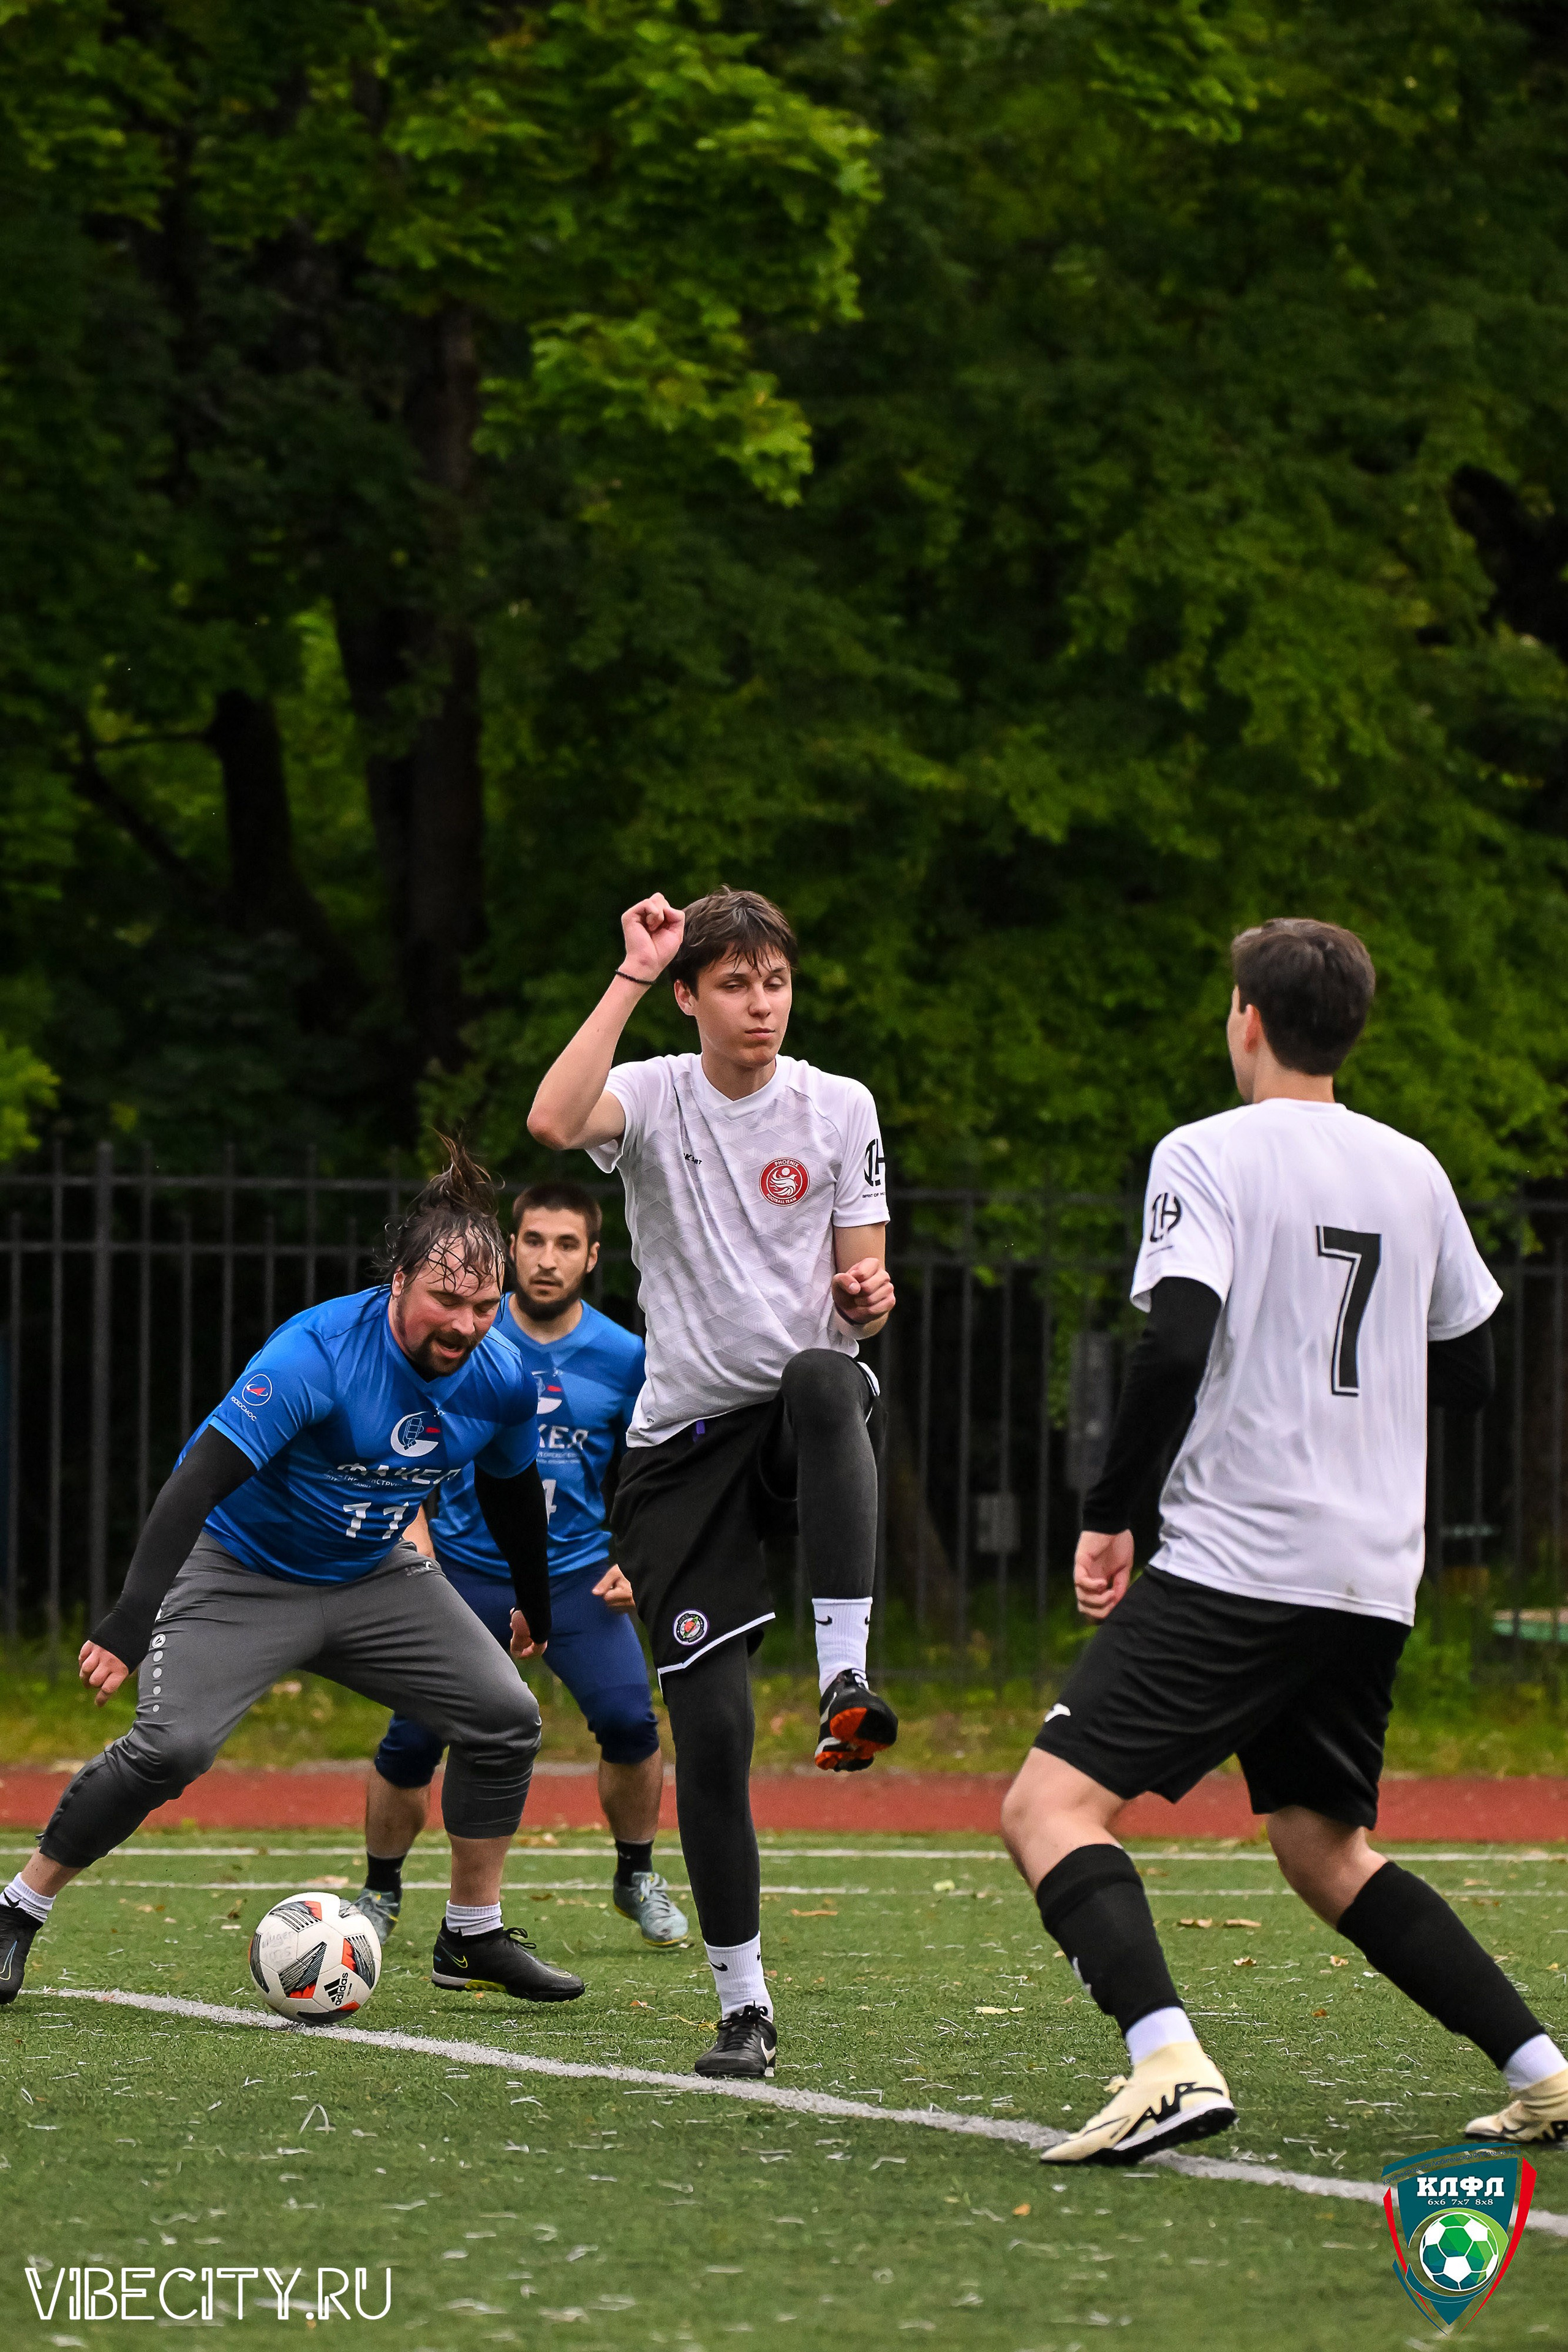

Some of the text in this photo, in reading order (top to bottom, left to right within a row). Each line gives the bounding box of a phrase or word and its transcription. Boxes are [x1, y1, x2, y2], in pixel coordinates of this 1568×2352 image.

[766, 1193, 785, 1204] FOOTBALL
[1316, 1225, 1382, 1398] 7
[343, 1501, 409, 1539] 11
[335, 1972, 349, 2006] adidas
